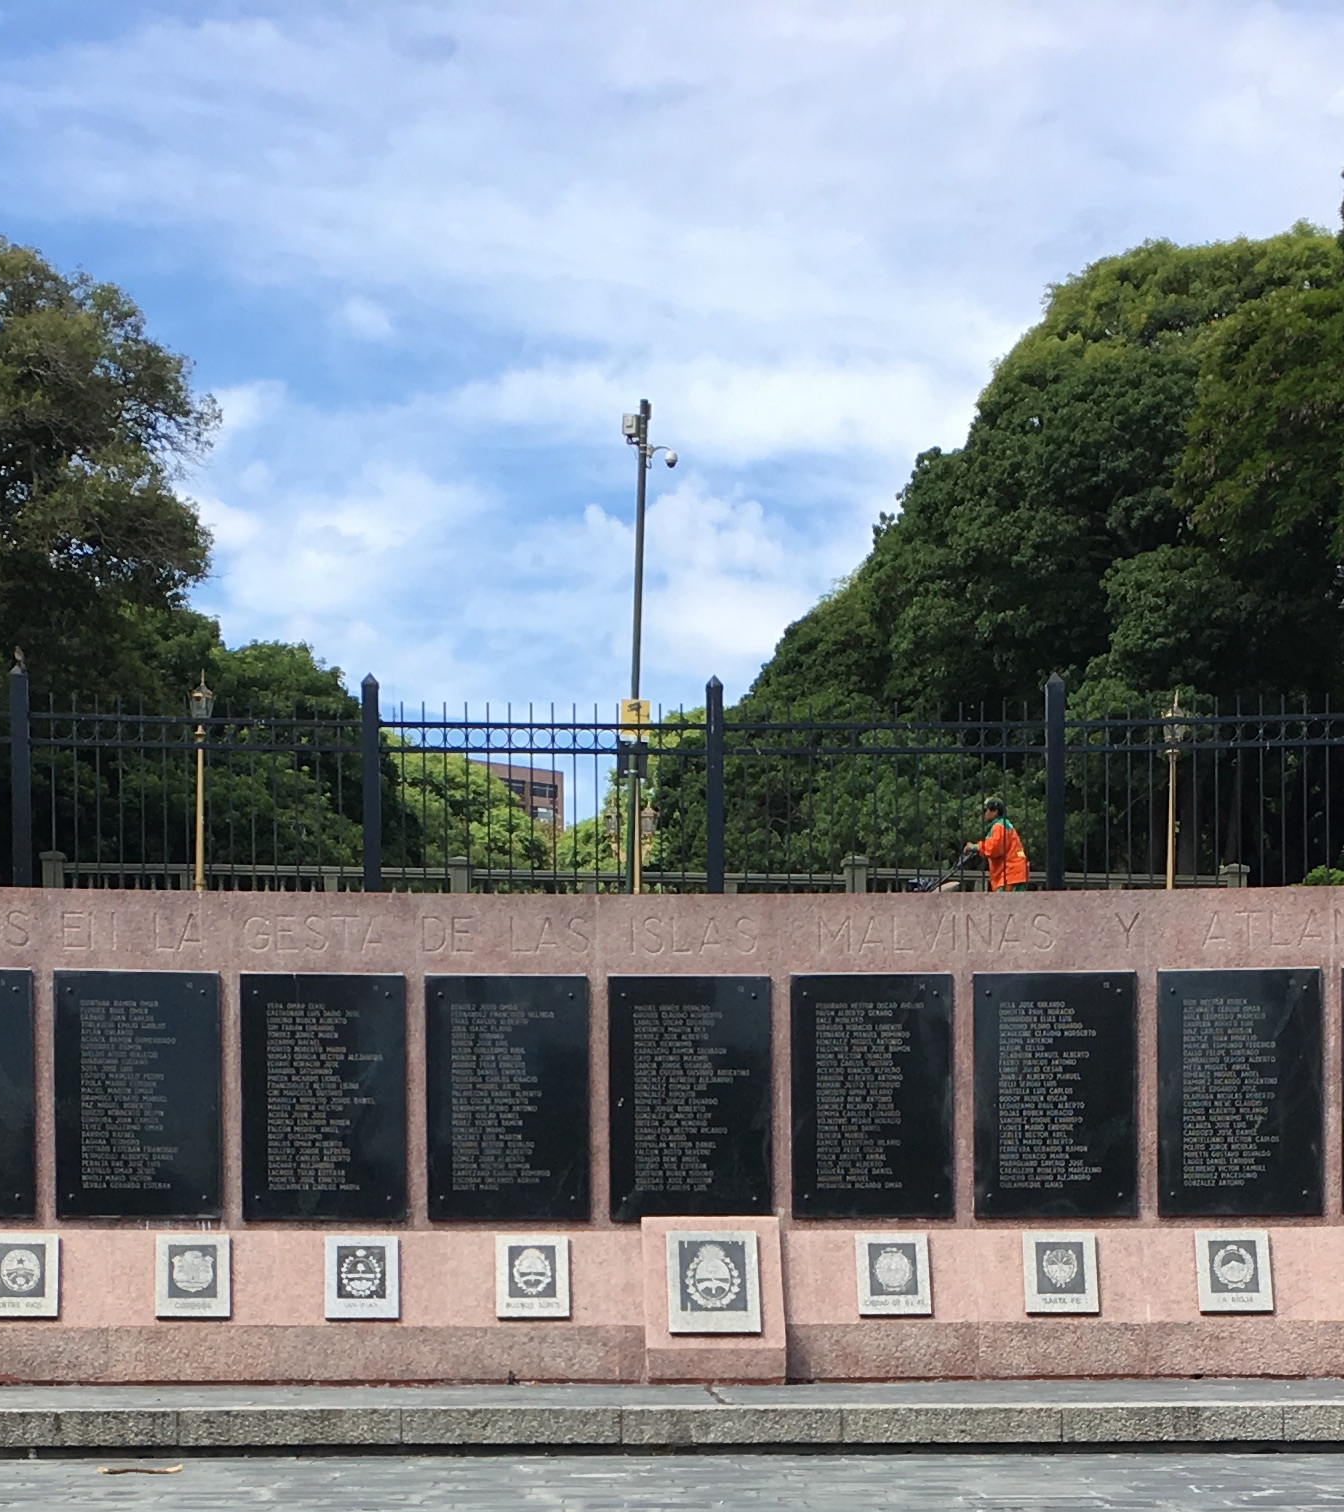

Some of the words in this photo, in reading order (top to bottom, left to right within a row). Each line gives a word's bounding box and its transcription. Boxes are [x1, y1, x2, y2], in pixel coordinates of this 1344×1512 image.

[153, 912, 203, 952] LA
[242, 915, 384, 955] GESTA
[420, 915, 474, 955] DE
[511, 915, 592, 955] LAS
[629, 915, 758, 955] ISLAS
[816, 912, 1056, 955] MALVINAS
[1114, 910, 1140, 951] Y
[1255, 1135, 1279, 1143] CARLOS
